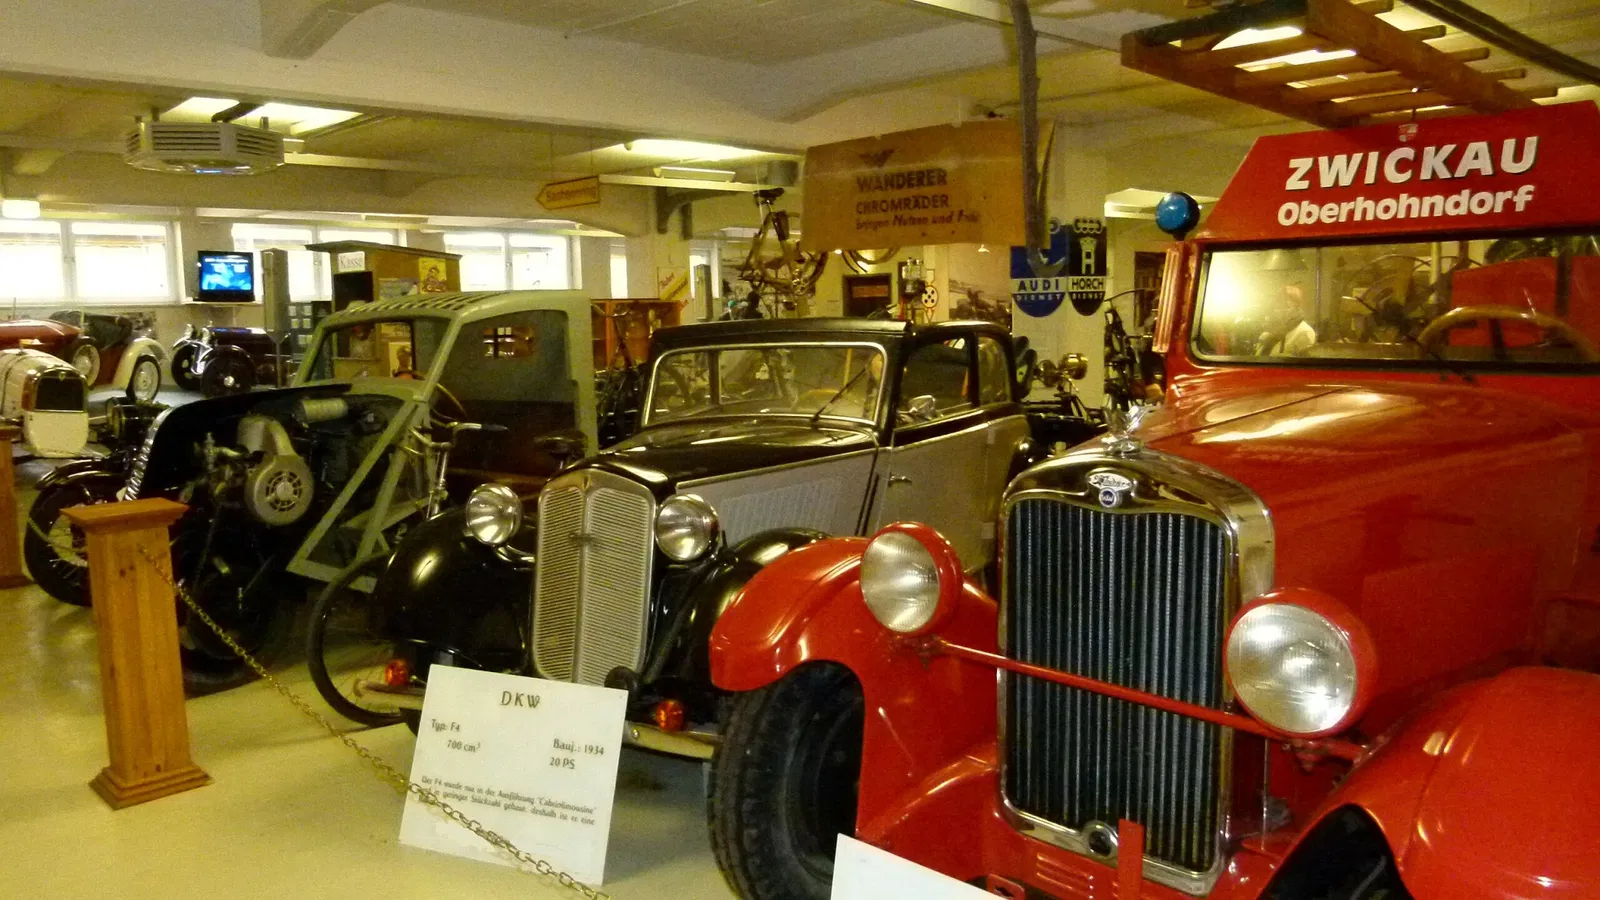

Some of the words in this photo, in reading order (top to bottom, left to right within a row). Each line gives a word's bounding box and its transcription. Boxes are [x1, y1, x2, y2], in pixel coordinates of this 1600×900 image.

[1285, 136, 1539, 191] ZWICKAU
[856, 168, 947, 193] WANDERER
[856, 194, 949, 215] CHROMRÄDER
[1278, 185, 1536, 226] Oberhohndorf
[932, 210, 954, 224] und
[1018, 279, 1059, 292] AUDI
[1072, 278, 1104, 290] HORCH
[1016, 293, 1061, 301] DIENST
[1072, 292, 1103, 300] DIENST
[501, 690, 541, 708] DKW
[450, 722, 460, 732] F4
[447, 740, 462, 750] 700
[584, 745, 604, 755] 1934
[550, 757, 560, 767] 20
[563, 759, 575, 769] PS
[444, 781, 462, 790] wurde
[498, 790, 534, 805] Ausführung
[471, 795, 500, 808] Stückzahl
[530, 807, 556, 818] deshalb
[581, 817, 595, 825] eine
